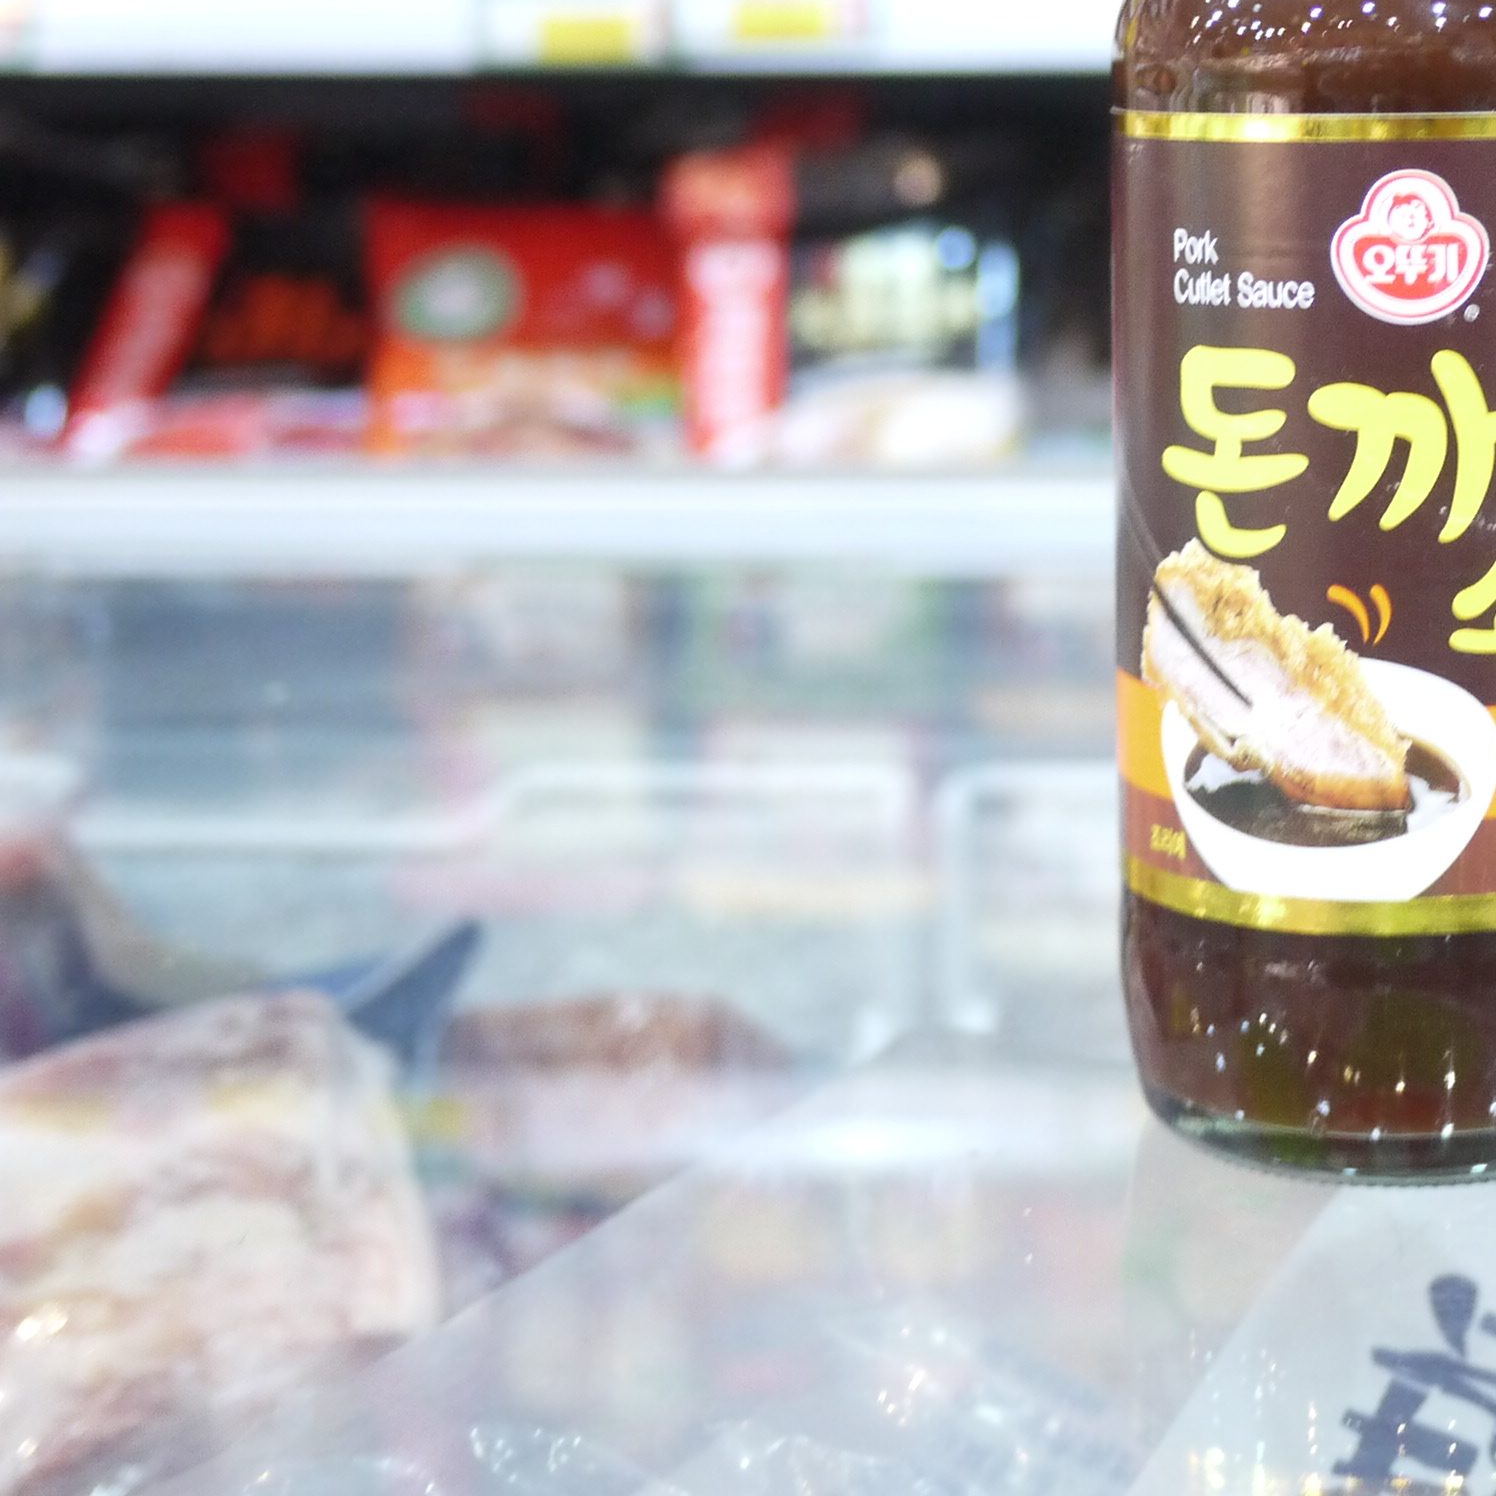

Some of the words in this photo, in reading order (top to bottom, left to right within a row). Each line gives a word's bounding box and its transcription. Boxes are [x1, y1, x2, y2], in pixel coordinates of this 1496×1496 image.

[1173, 227, 1219, 265] Pork
[1173, 267, 1232, 307] Cutlet
[1236, 270, 1316, 310] Sauce
